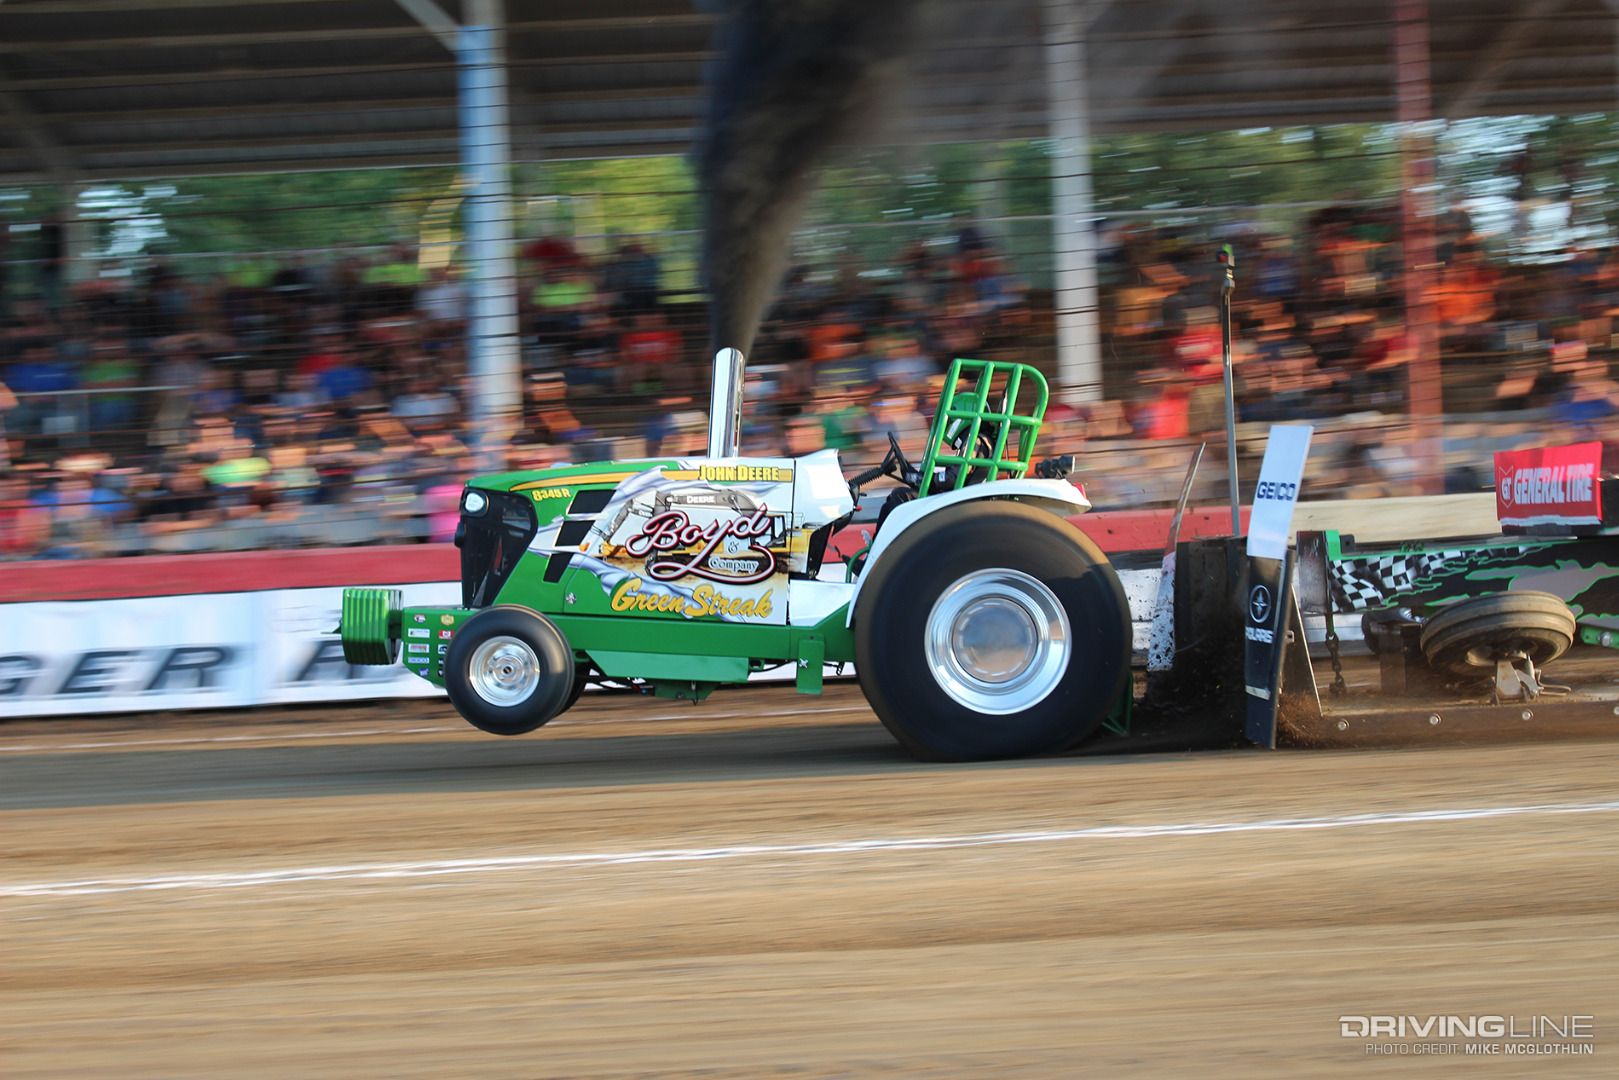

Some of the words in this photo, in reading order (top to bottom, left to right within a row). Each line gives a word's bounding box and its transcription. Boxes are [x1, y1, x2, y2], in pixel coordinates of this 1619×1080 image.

[698, 465, 738, 482] JOHN
[737, 466, 780, 482] DEERE
[1256, 481, 1296, 501] GEICO
[1514, 467, 1566, 505] GENERAL
[1566, 462, 1595, 502] TIRE
[686, 495, 716, 504] DEERE
[625, 503, 776, 584] Boyd
[727, 541, 739, 554] &
[708, 557, 760, 574] Company
[611, 578, 685, 615] Green
[686, 585, 774, 618] Streak
